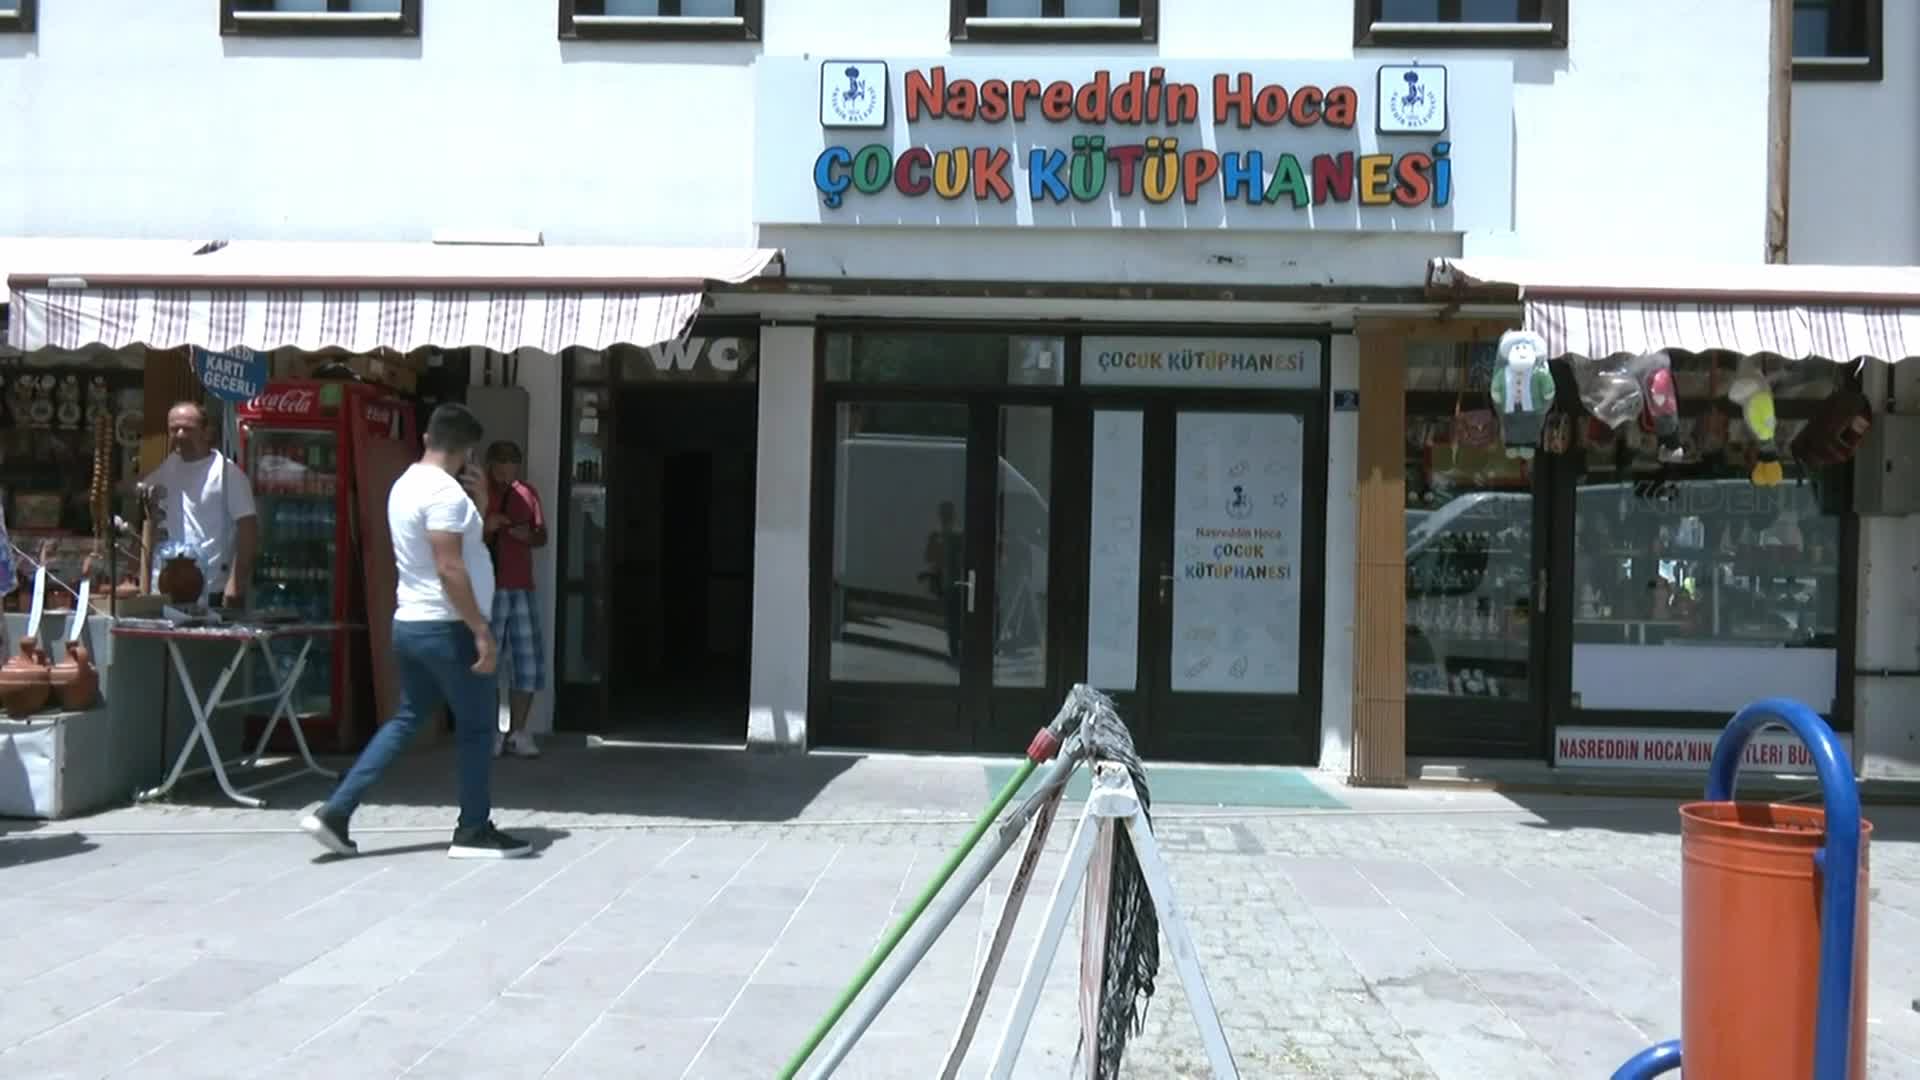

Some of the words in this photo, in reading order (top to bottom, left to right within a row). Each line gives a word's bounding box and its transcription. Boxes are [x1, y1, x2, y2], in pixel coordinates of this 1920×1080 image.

[903, 66, 1198, 125] Nasreddin
[1213, 72, 1358, 128] Hoca
[813, 145, 1011, 208] ÇOCUK
[1028, 135, 1452, 208] KÜTÜPHANESİ
[206, 355, 244, 377] KARTI
[648, 337, 739, 371] WC
[1098, 350, 1162, 371] ÇOCUK
[1167, 348, 1304, 373] KÜTÜPHANESİ
[1195, 527, 1252, 539] Nasreddin
[1254, 528, 1282, 540] Hoca
[1213, 543, 1264, 560] ÇOCUK
[1185, 561, 1291, 580] KÜTÜPHANESİ
[1559, 736, 1638, 761] NASREDDİN
[1643, 738, 1712, 763] HOCA'NIN
